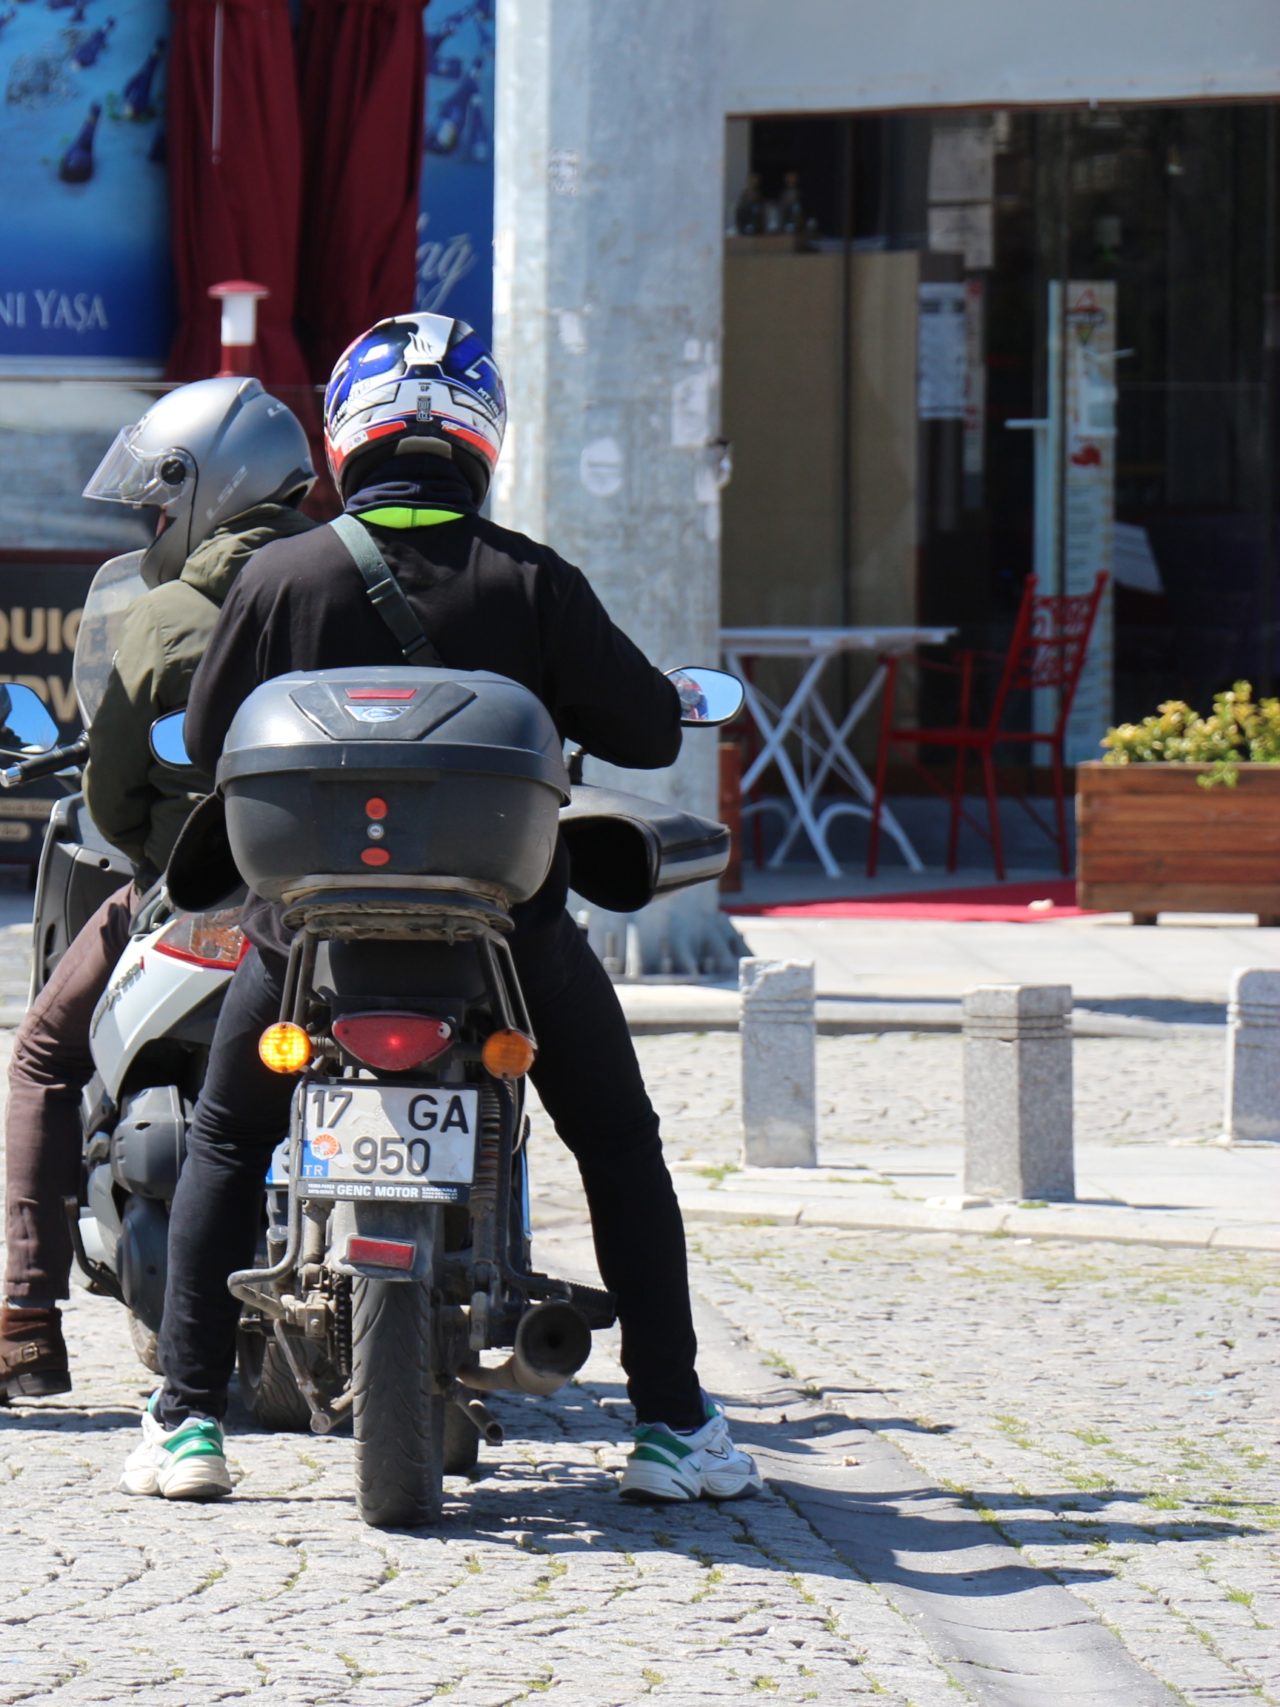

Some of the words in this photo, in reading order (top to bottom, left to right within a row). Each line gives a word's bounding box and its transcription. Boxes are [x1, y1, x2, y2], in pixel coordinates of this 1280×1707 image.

[34, 289, 110, 334] YAŞA
[312, 1089, 353, 1129] 17
[407, 1093, 470, 1135] GA
[303, 1164, 323, 1176] TR
[352, 1136, 431, 1177] 950
[336, 1184, 372, 1197] GENC
[374, 1185, 419, 1198] MOTOR
